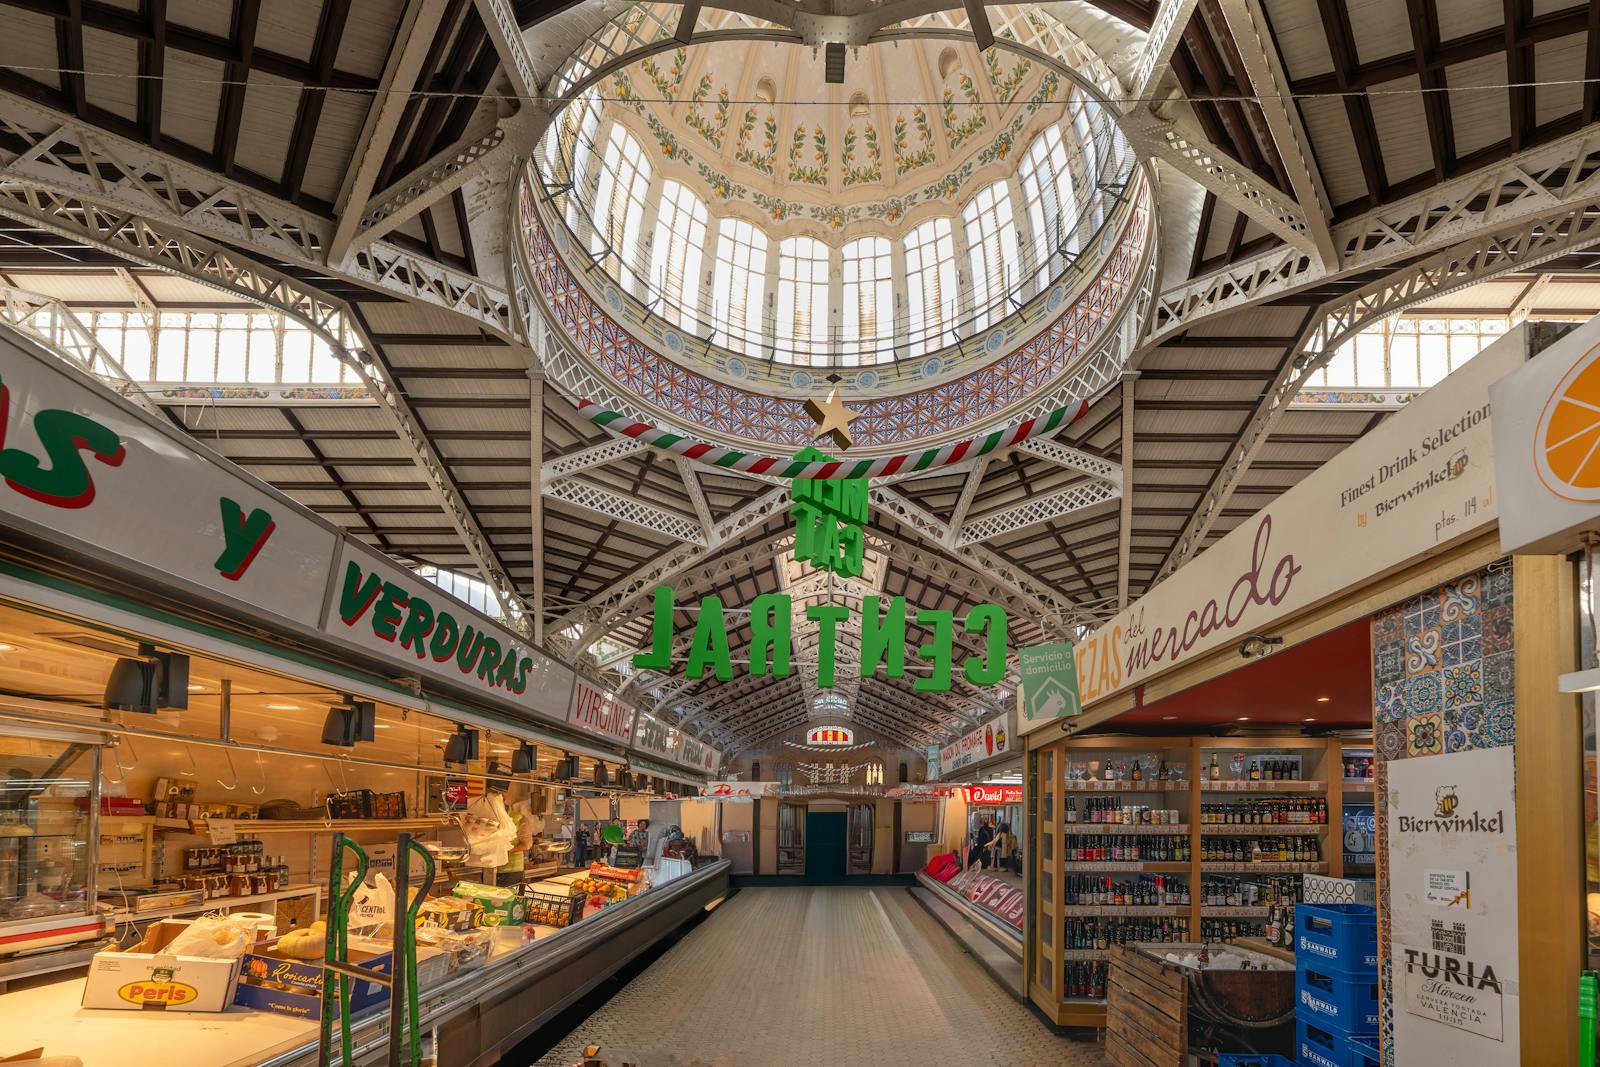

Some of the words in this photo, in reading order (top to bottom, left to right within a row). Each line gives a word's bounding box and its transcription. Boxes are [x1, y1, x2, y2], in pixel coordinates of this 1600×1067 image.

[1340, 476, 1376, 508] Finest
[1378, 448, 1418, 484] Drink
[1421, 403, 1492, 457] Selection
[1357, 511, 1368, 528] by
[1375, 459, 1453, 517] Bierwinkel
[1464, 495, 1477, 518] 114
[214, 497, 276, 581] Y
[339, 560, 533, 695] VERDURAS
[1126, 513, 1302, 678] mercado
[1123, 605, 1146, 645] del
[1023, 650, 1062, 664] Servicio
[1025, 661, 1072, 675] domicilio
[1075, 624, 1122, 705] EZAS
[974, 787, 1002, 801] David
[1398, 809, 1504, 834] Bierwinkel
[1307, 942, 1337, 956] SANWALD
[1404, 948, 1503, 995] TURIA
[129, 985, 187, 1000] Peris
[1421, 979, 1477, 1004] Märzen
[1416, 994, 1448, 1006] CERVEZA
[1451, 1002, 1487, 1016] TOSTADA
[1420, 1000, 1482, 1024] VALENCIA
